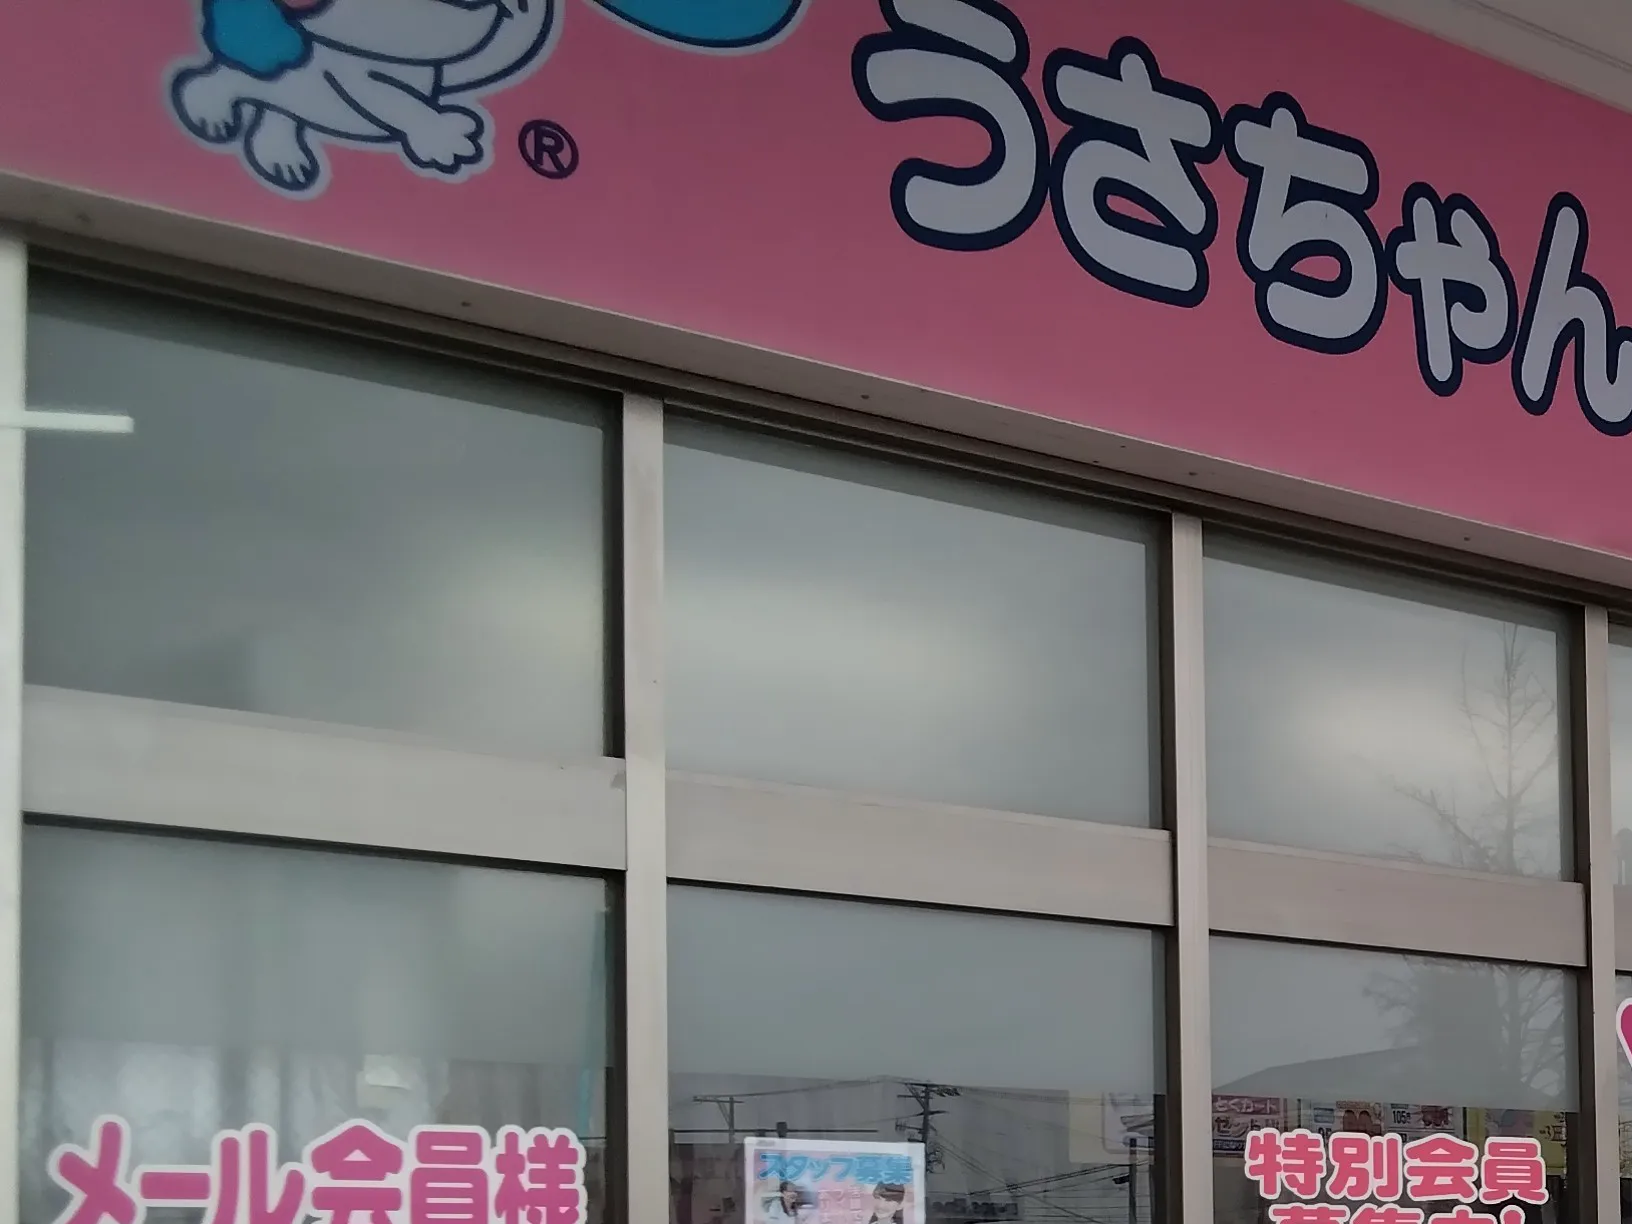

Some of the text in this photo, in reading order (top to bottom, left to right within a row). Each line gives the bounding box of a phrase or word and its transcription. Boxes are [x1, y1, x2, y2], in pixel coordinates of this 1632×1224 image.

[759, 1153, 912, 1184] スタッフ募集
[1245, 1127, 1549, 1206] 特別会員
